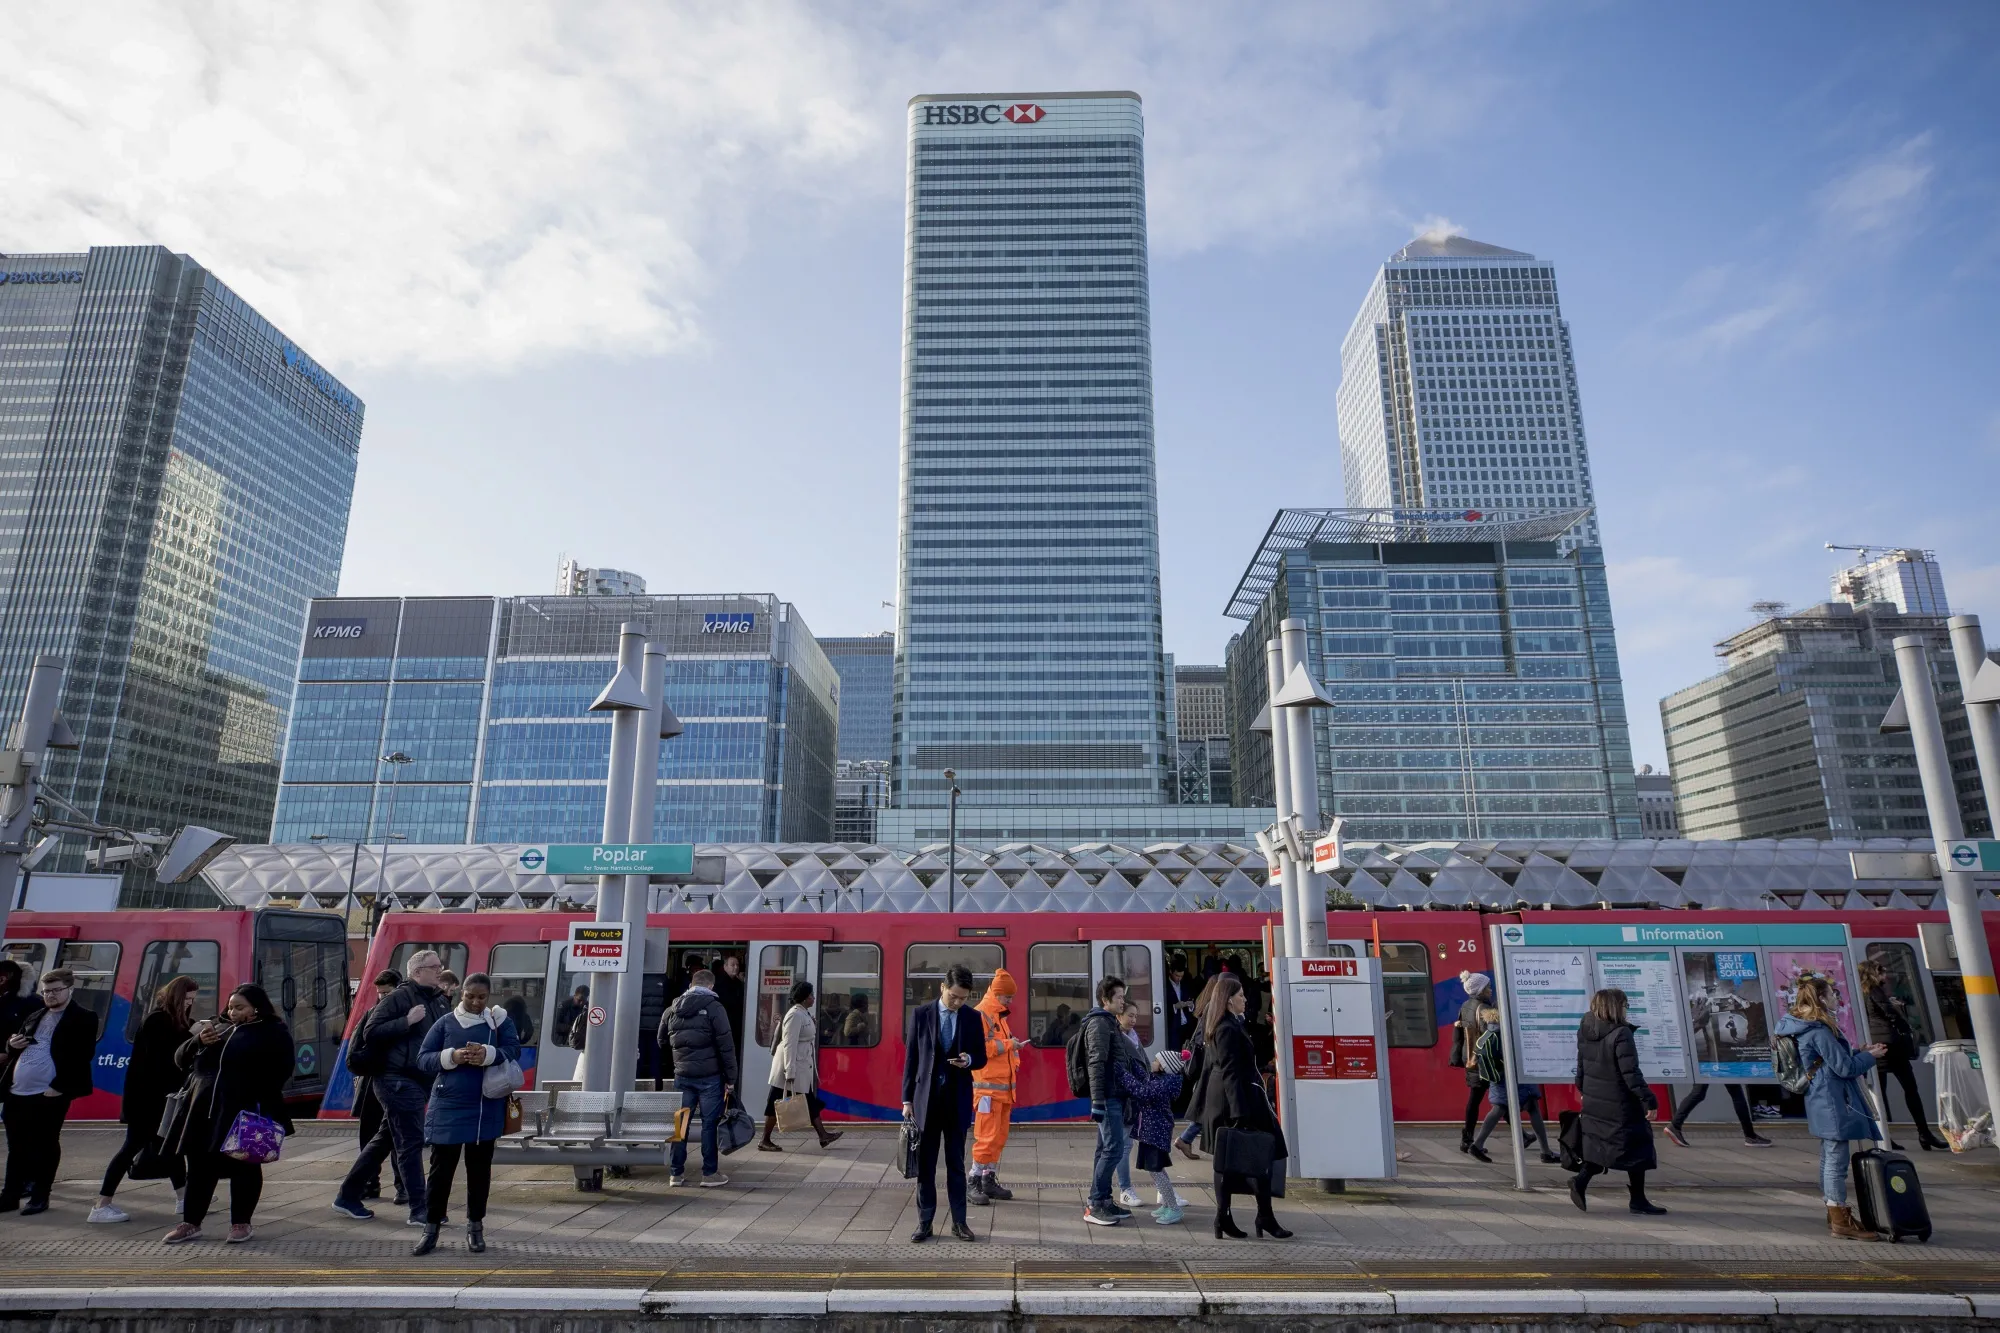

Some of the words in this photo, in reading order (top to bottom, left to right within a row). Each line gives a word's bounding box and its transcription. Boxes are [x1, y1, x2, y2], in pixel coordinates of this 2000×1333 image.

[924, 105, 1000, 125] HSBC
[9, 271, 83, 283] BARCLAYS
[297, 360, 354, 413] BARCLAYS
[313, 625, 362, 638] KPMG
[701, 621, 750, 633] KPMG
[593, 847, 647, 865] Poplar
[583, 930, 598, 938] Way
[1641, 928, 1724, 940] Information
[591, 946, 613, 954] Alarm
[1457, 939, 1477, 953] 26
[1308, 963, 1336, 972] Alarm
[1533, 968, 1566, 976] planned
